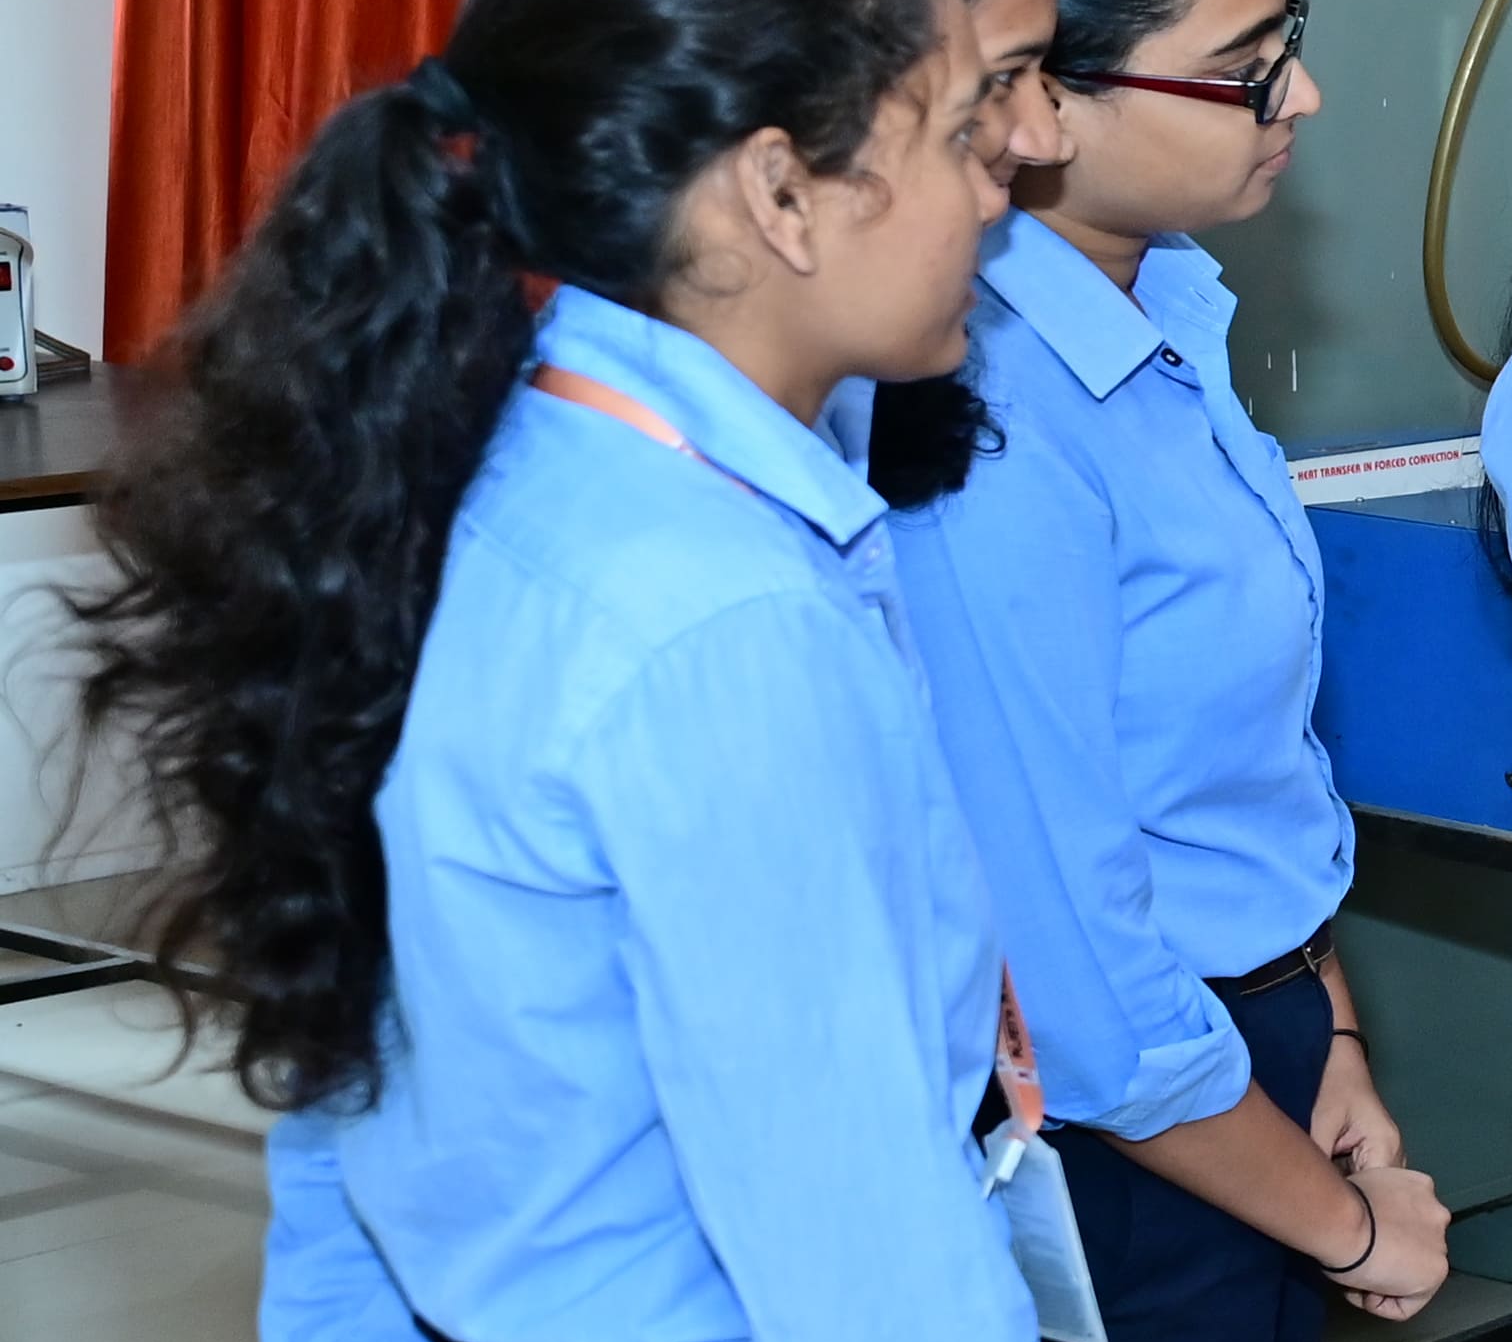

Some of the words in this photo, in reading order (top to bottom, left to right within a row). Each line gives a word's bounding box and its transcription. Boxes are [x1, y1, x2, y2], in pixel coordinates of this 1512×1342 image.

[1298, 469, 1318, 481] HEAT
[1320, 464, 1362, 479] TRANSFER
[1364, 462, 1372, 471] IN
[1375, 457, 1406, 471] FORCED
[1409, 450, 1460, 467] CONVECTION
